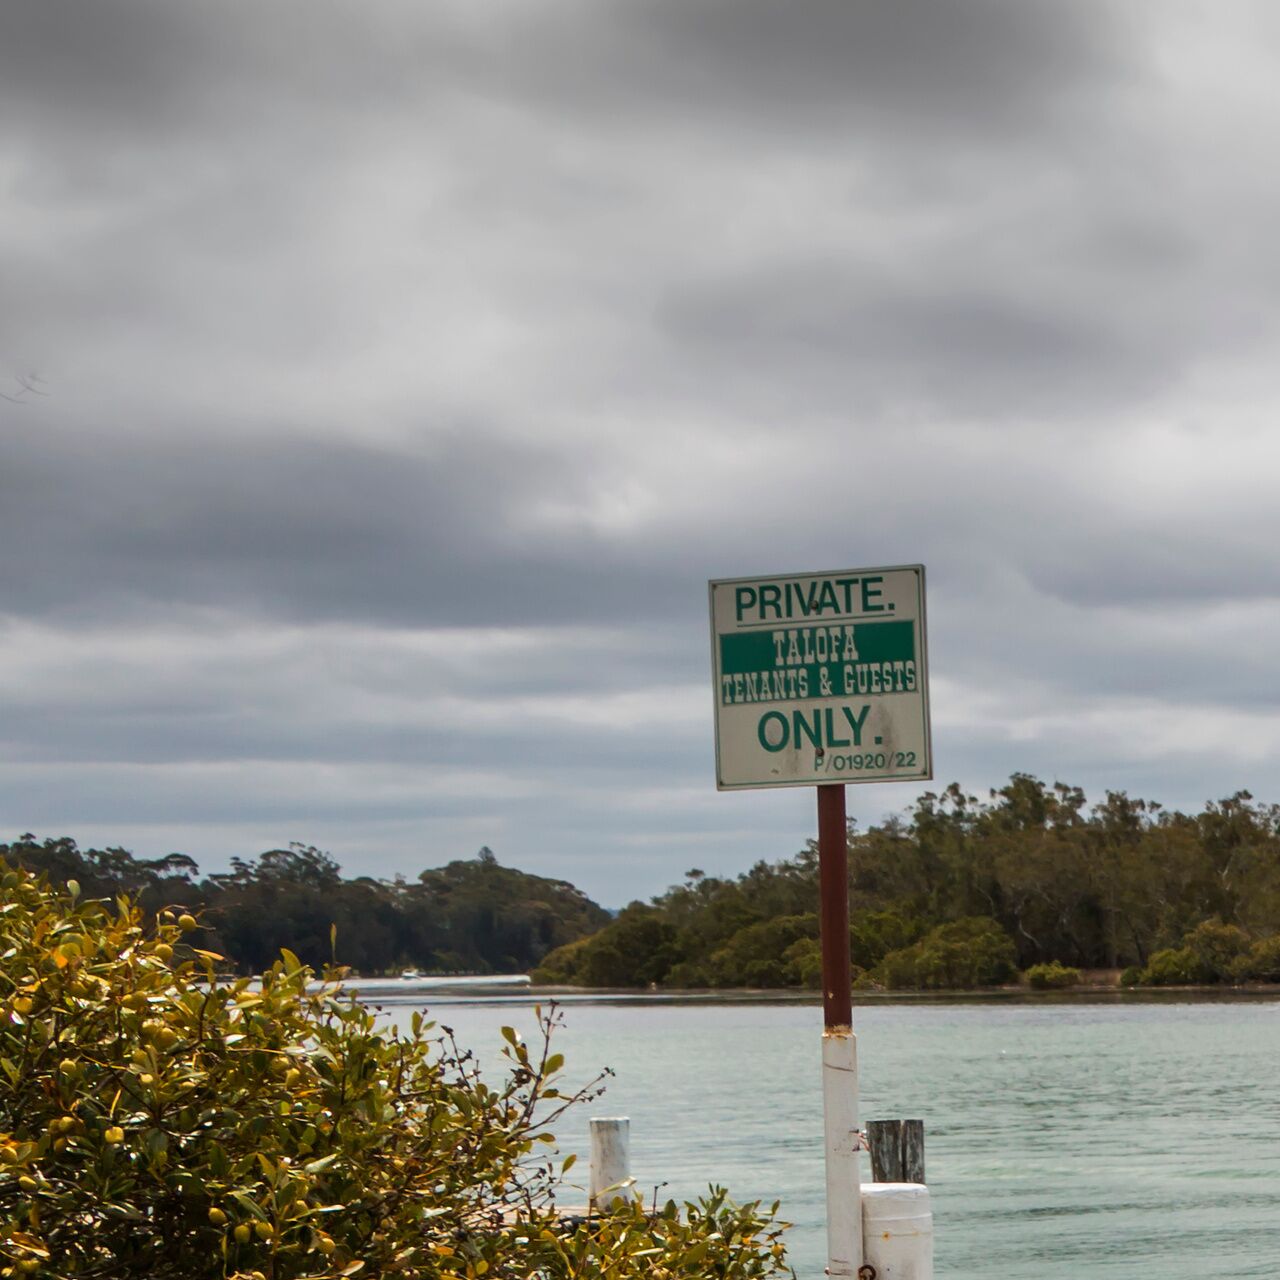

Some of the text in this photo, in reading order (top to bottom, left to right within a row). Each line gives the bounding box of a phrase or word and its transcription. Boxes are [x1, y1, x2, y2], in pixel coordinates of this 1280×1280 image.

[735, 576, 895, 622] PRIVATE.
[773, 625, 859, 666] TALOFA
[722, 660, 916, 704] TENANTS & GUESTS
[757, 705, 883, 753] ONLY.
